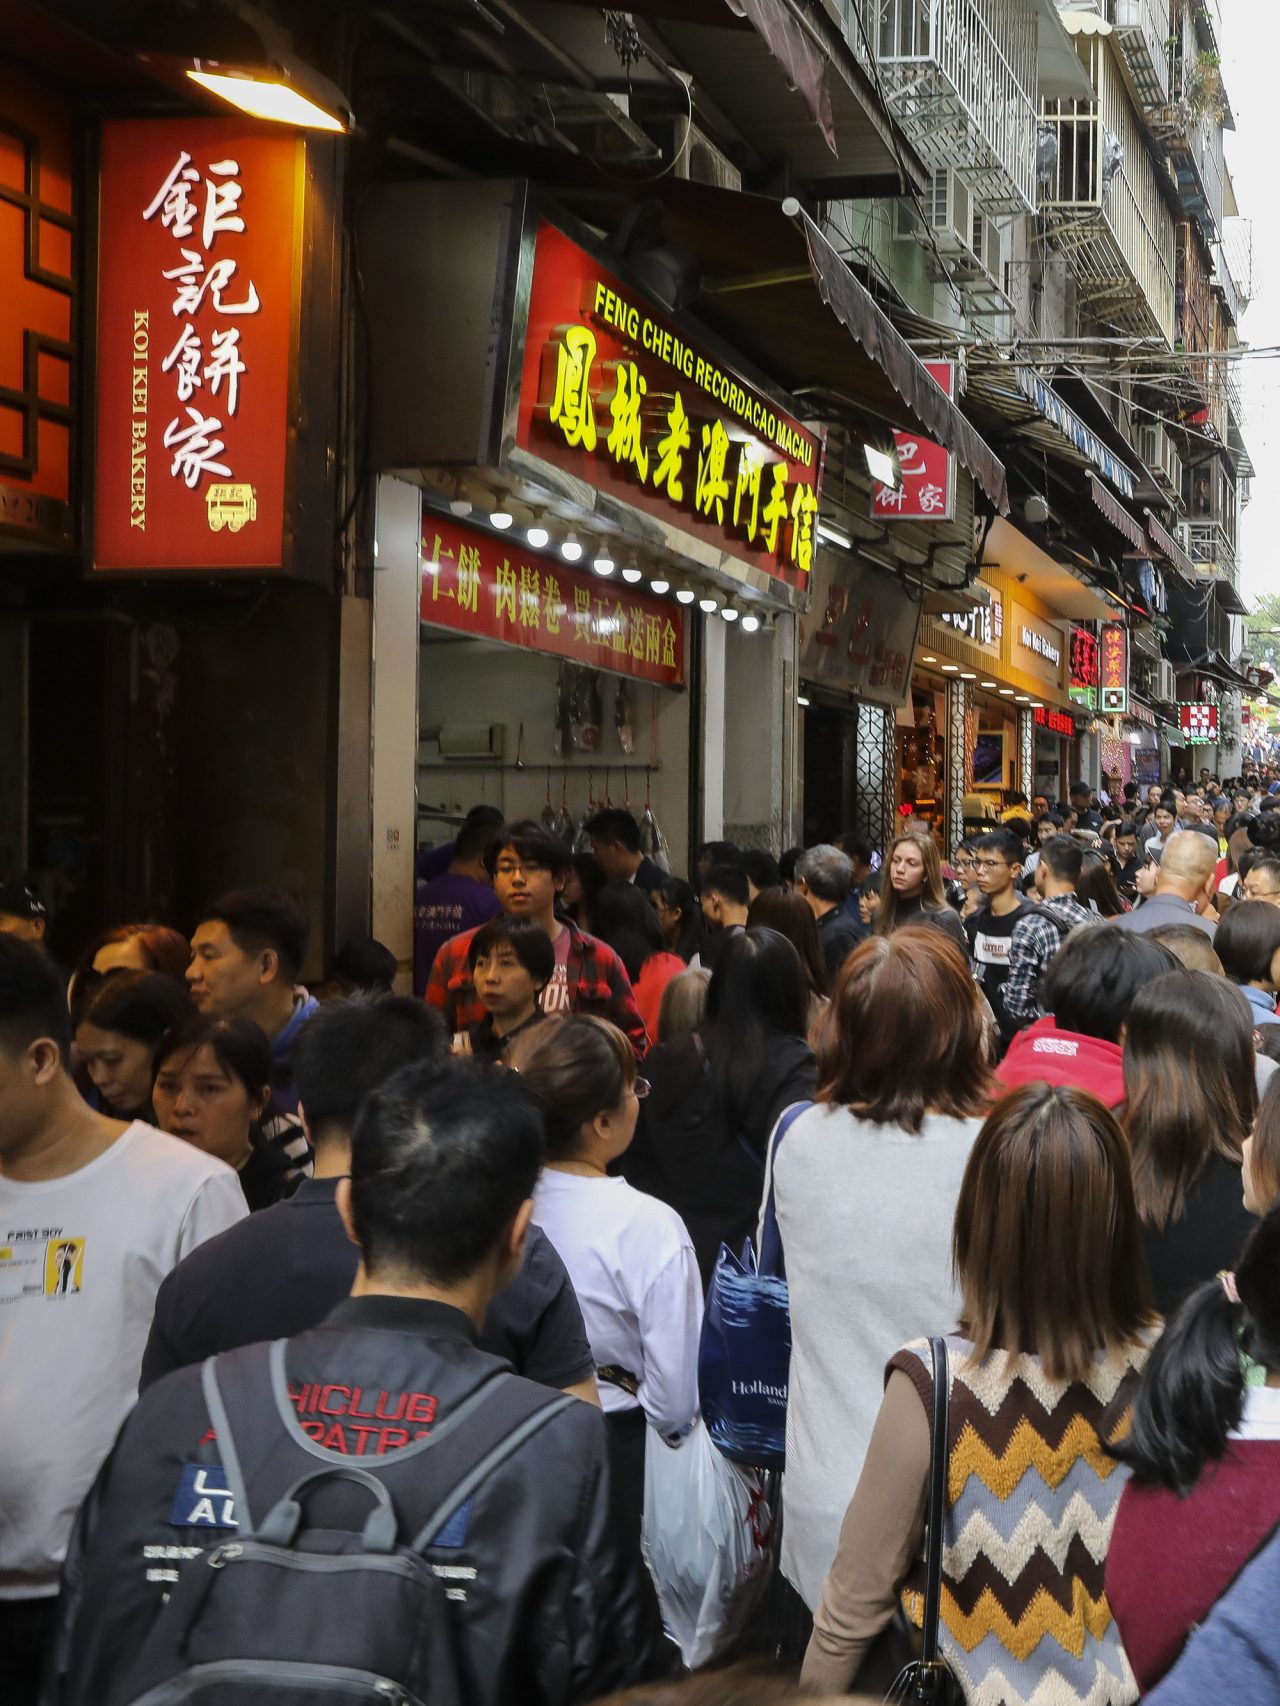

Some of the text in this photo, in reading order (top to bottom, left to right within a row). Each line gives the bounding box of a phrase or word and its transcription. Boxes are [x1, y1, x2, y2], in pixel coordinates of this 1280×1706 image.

[143, 150, 260, 489] 鉅記餅家
[594, 281, 640, 341] FENG
[641, 317, 694, 378] CHENG
[776, 419, 813, 468] MACAU
[130, 309, 149, 532] KOI KEI BAKERY
[422, 533, 481, 614] 仁餅
[289, 1383, 438, 1423] HICLUB
[731, 1379, 788, 1399] Holland
